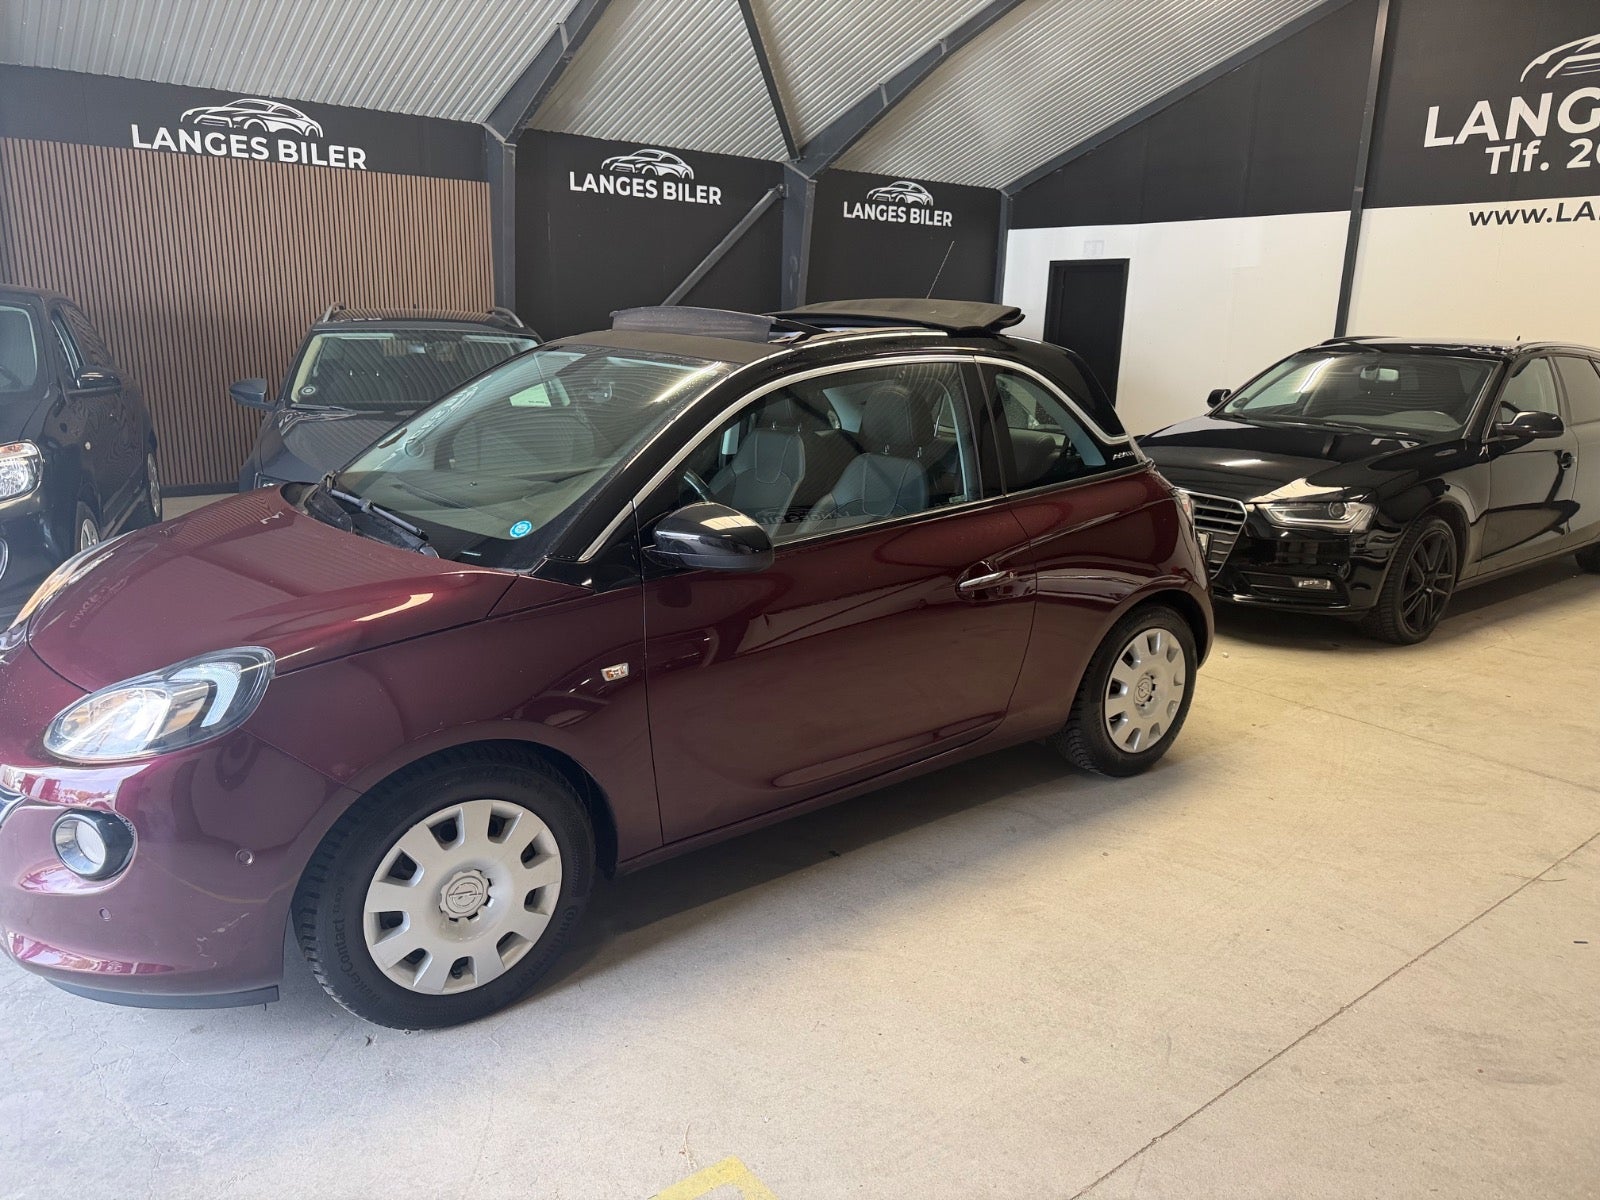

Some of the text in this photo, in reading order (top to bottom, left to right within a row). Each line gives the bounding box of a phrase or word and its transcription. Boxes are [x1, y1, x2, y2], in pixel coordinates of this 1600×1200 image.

[1424, 86, 1600, 148] LANG
[131, 124, 367, 170] LANGES BILER
[1485, 138, 1600, 175] Tlf. 2
[569, 171, 722, 206] LANGES BILER
[843, 201, 953, 227] LANGES BILER
[1469, 201, 1600, 226] www.LA
